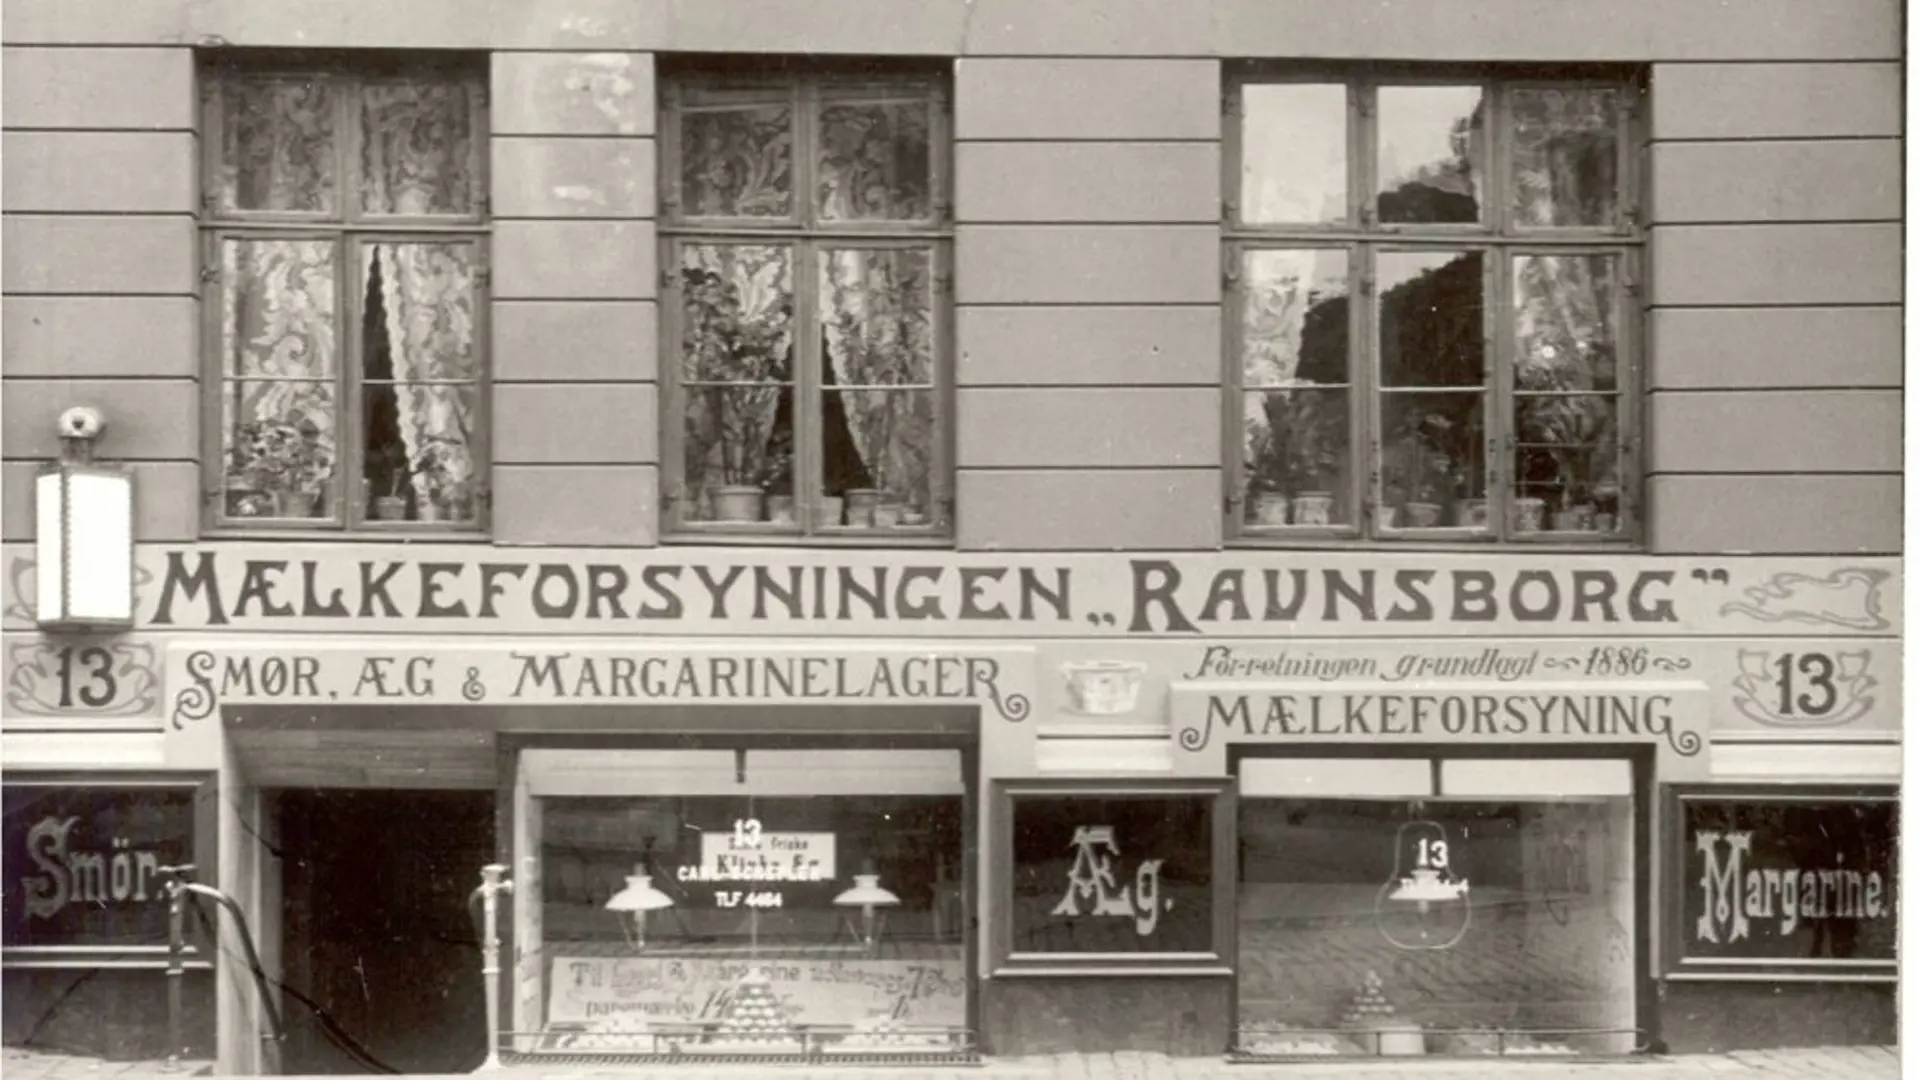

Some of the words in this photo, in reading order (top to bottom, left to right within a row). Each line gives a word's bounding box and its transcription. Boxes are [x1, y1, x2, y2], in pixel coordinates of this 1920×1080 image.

[150, 551, 1072, 624] MÆLKEFORSYNINGEN
[56, 646, 117, 708] 13
[352, 656, 435, 698] ÆG
[461, 667, 487, 701] &
[509, 652, 1030, 722] MARGARINELAGER
[1583, 645, 1650, 677] 1886
[1773, 651, 1837, 716] 13
[1178, 695, 1702, 757] MÆLKEFORSYNING
[1418, 837, 1449, 868] 13
